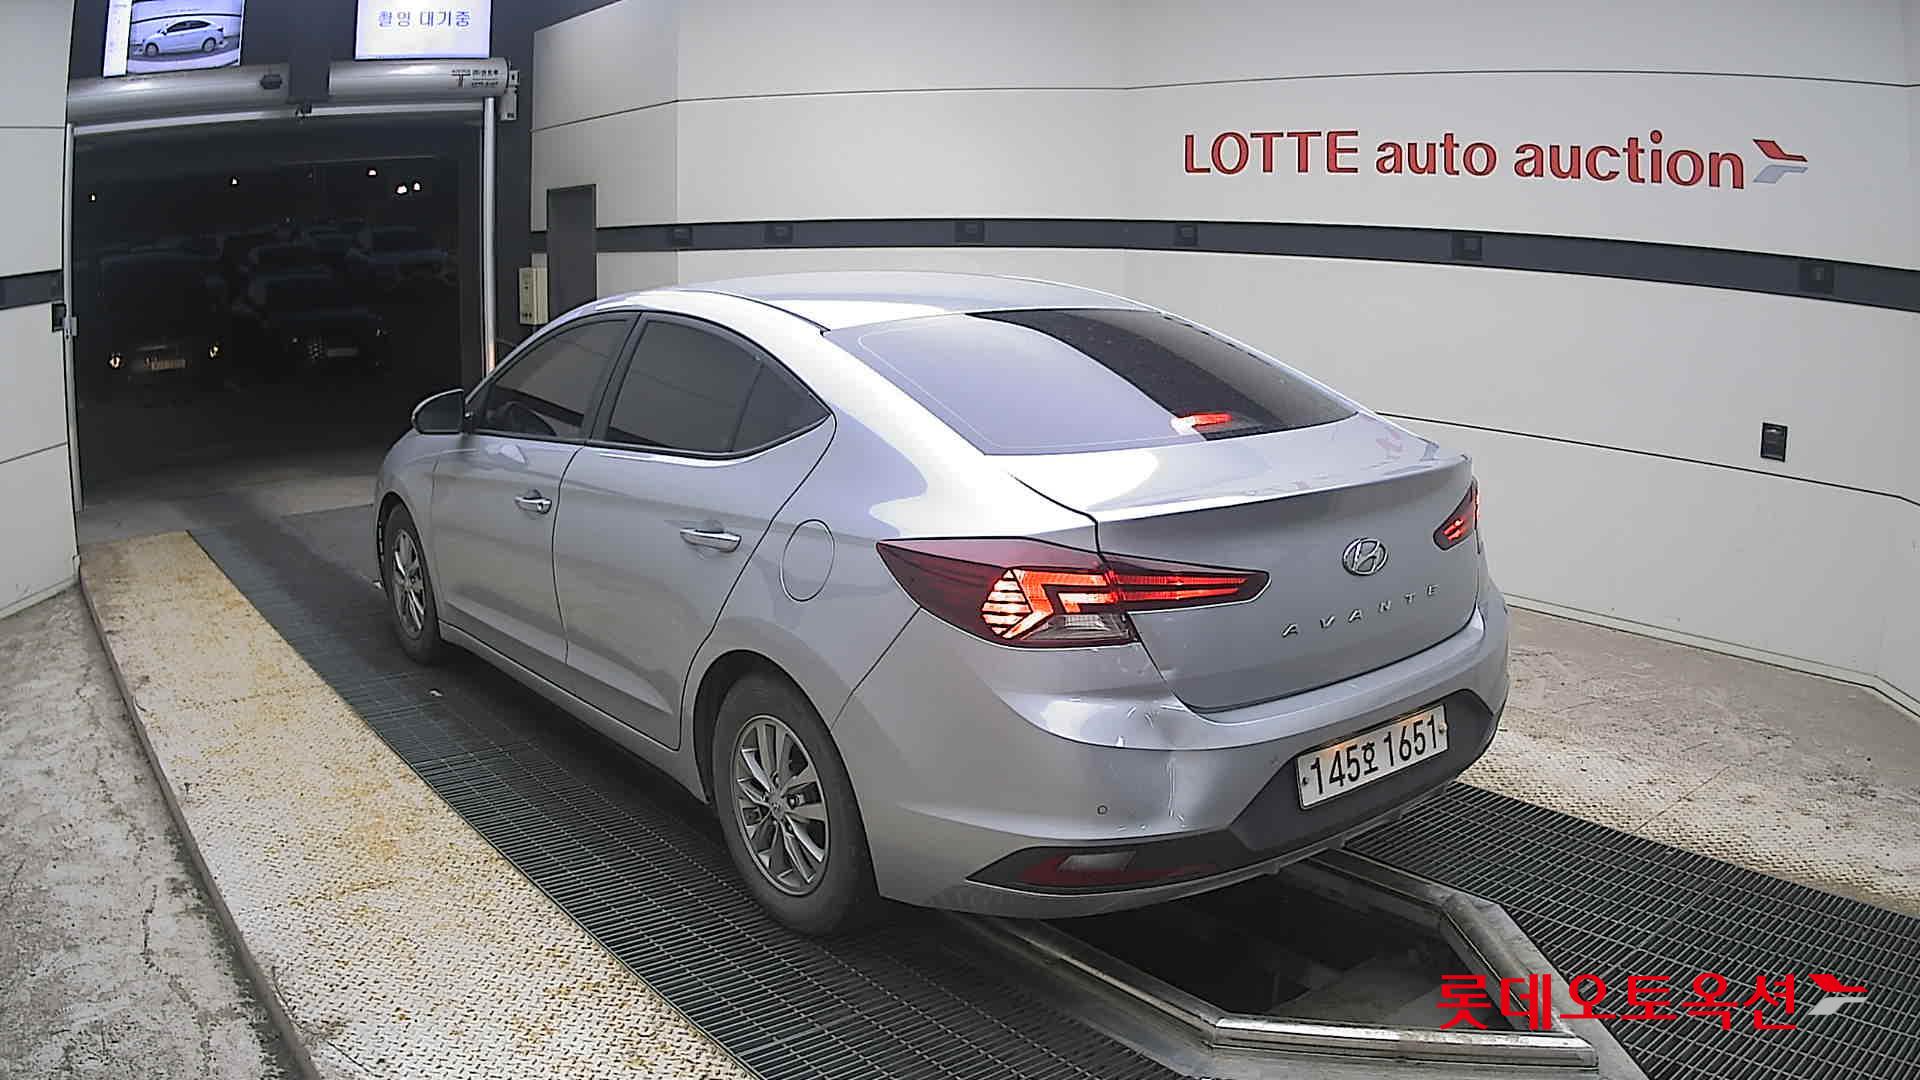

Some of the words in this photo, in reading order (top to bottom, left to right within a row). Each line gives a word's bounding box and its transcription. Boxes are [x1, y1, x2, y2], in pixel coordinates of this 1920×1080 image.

[419, 10, 471, 28] 대기중
[1184, 129, 1360, 175] LOTTE
[1375, 131, 1498, 177] auto
[1513, 130, 1744, 190] auction
[1281, 583, 1440, 638] AVANTE
[1310, 741, 1379, 795] 145호
[1383, 714, 1437, 768] 1651
